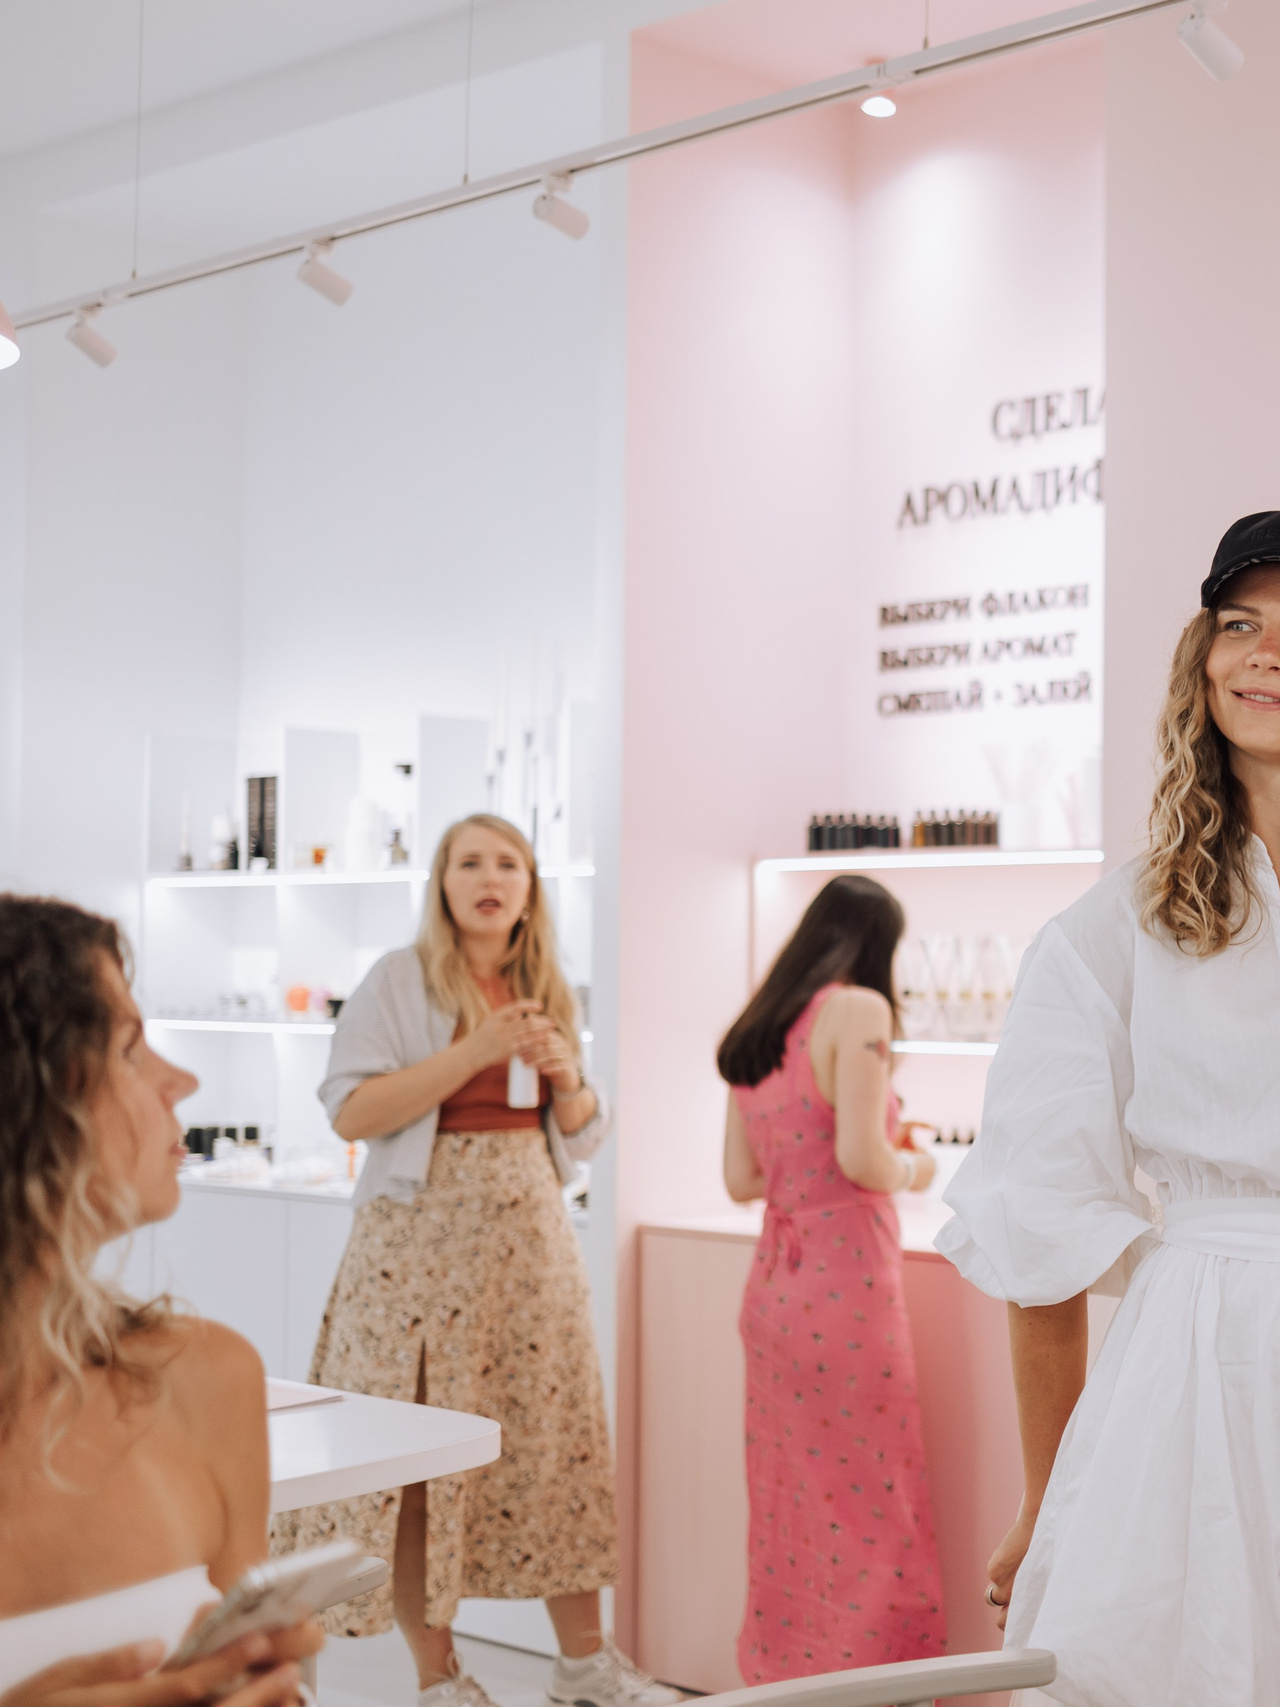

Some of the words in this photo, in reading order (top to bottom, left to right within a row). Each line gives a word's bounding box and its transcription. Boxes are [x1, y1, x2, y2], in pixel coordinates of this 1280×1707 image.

[877, 597, 971, 629] ВЫБЕРИ
[979, 583, 1089, 619] ФЛАКОН
[877, 642, 971, 674] ВЫБЕРИ
[979, 631, 1077, 664] АРОМАТ
[877, 679, 984, 719] СМЕШАЙ
[1013, 669, 1092, 707] ЗАЛЕЙ
